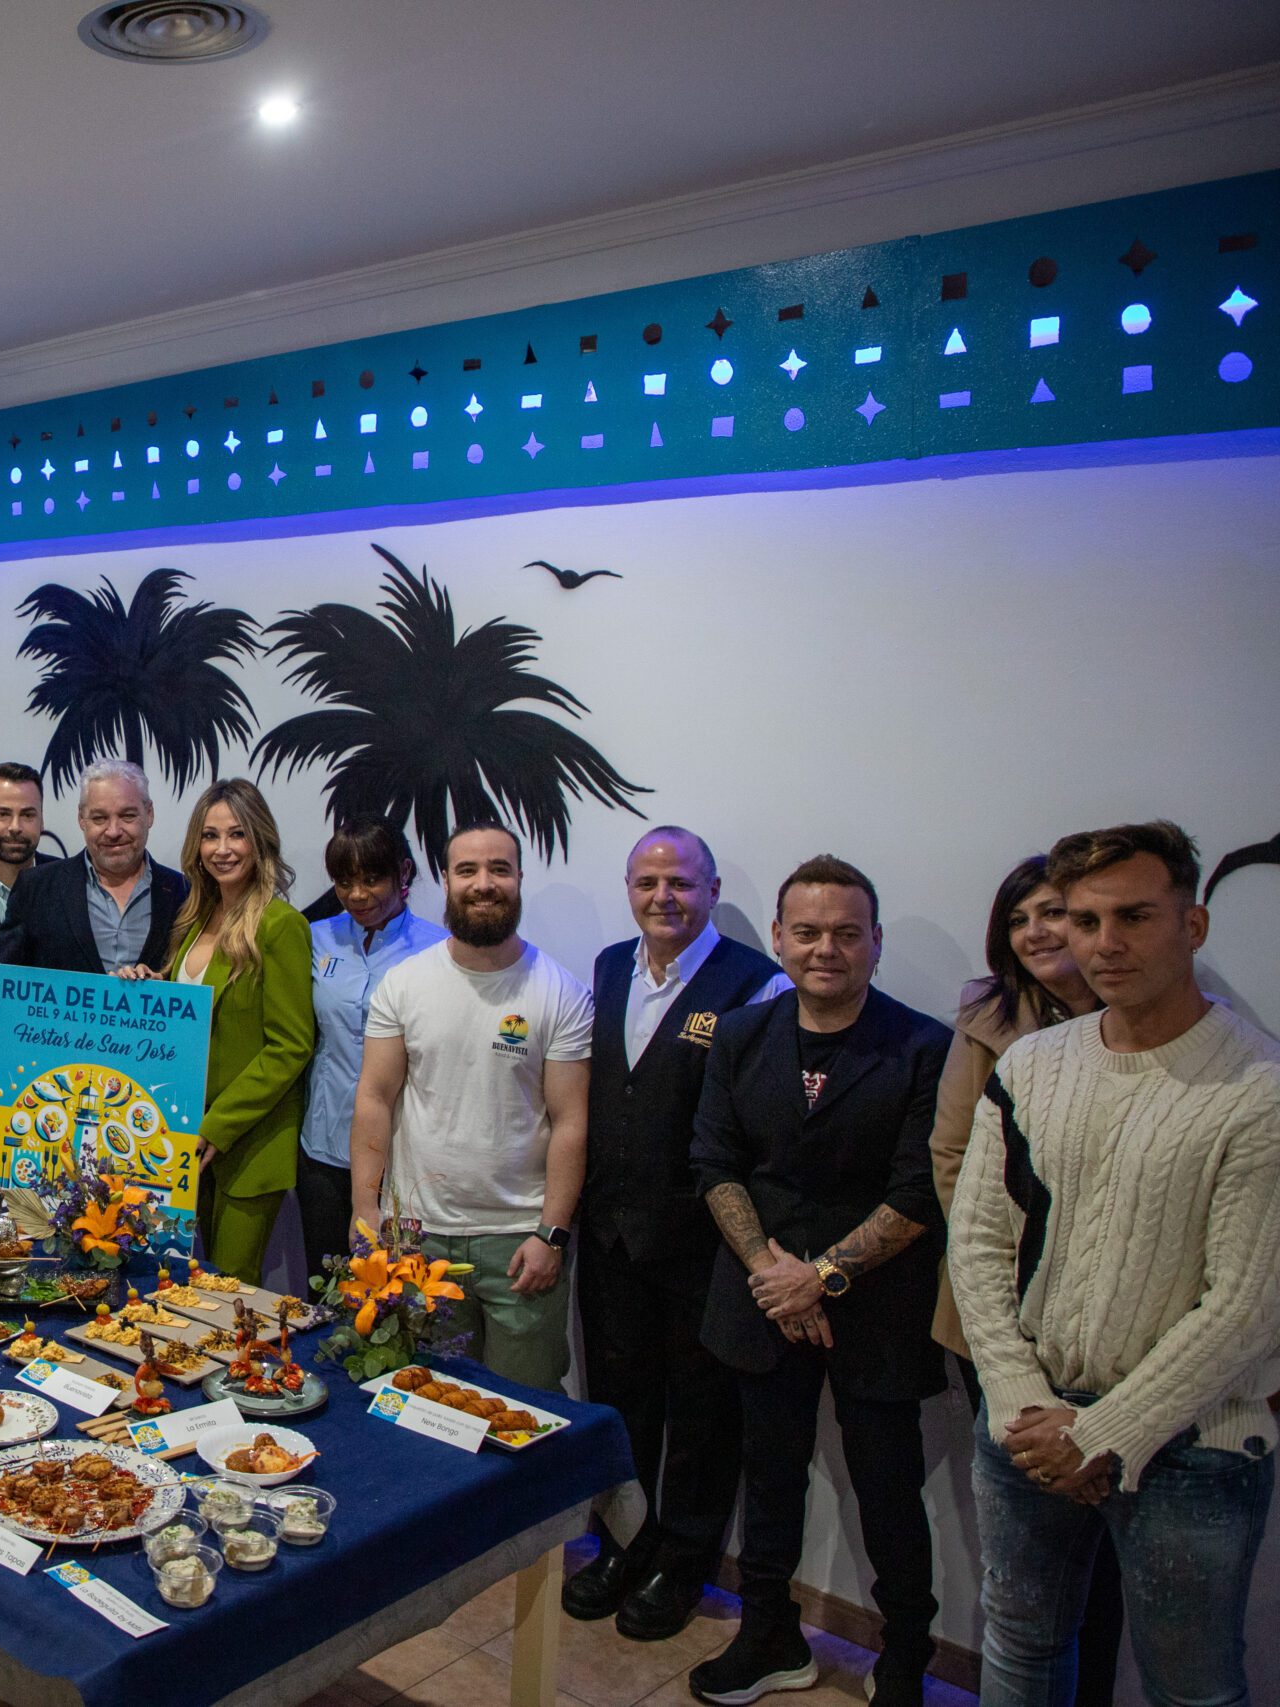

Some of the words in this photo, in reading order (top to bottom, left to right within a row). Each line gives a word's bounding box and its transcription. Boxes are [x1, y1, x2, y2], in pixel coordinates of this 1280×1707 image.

[1, 978, 58, 1005] RUTA
[65, 985, 95, 1009] DE
[102, 989, 131, 1014] LA
[139, 993, 198, 1021] TAPA
[27, 1005, 49, 1019] DEL
[52, 1008, 60, 1019] 9
[63, 1010, 79, 1022] AL
[83, 1011, 97, 1024] 19
[100, 1014, 117, 1026] DE
[120, 1017, 167, 1033] MARZO
[13, 1023, 72, 1049] Fiestas
[74, 1032, 96, 1051] de
[97, 1033, 133, 1056] San
[135, 1038, 177, 1063] José
[491, 1041, 528, 1056] BUENAVISTA
[195, 1419, 217, 1430] Ermita
[421, 1417, 436, 1428] New
[436, 1422, 459, 1437] Bongo
[5, 1550, 26, 1568] Tapas
